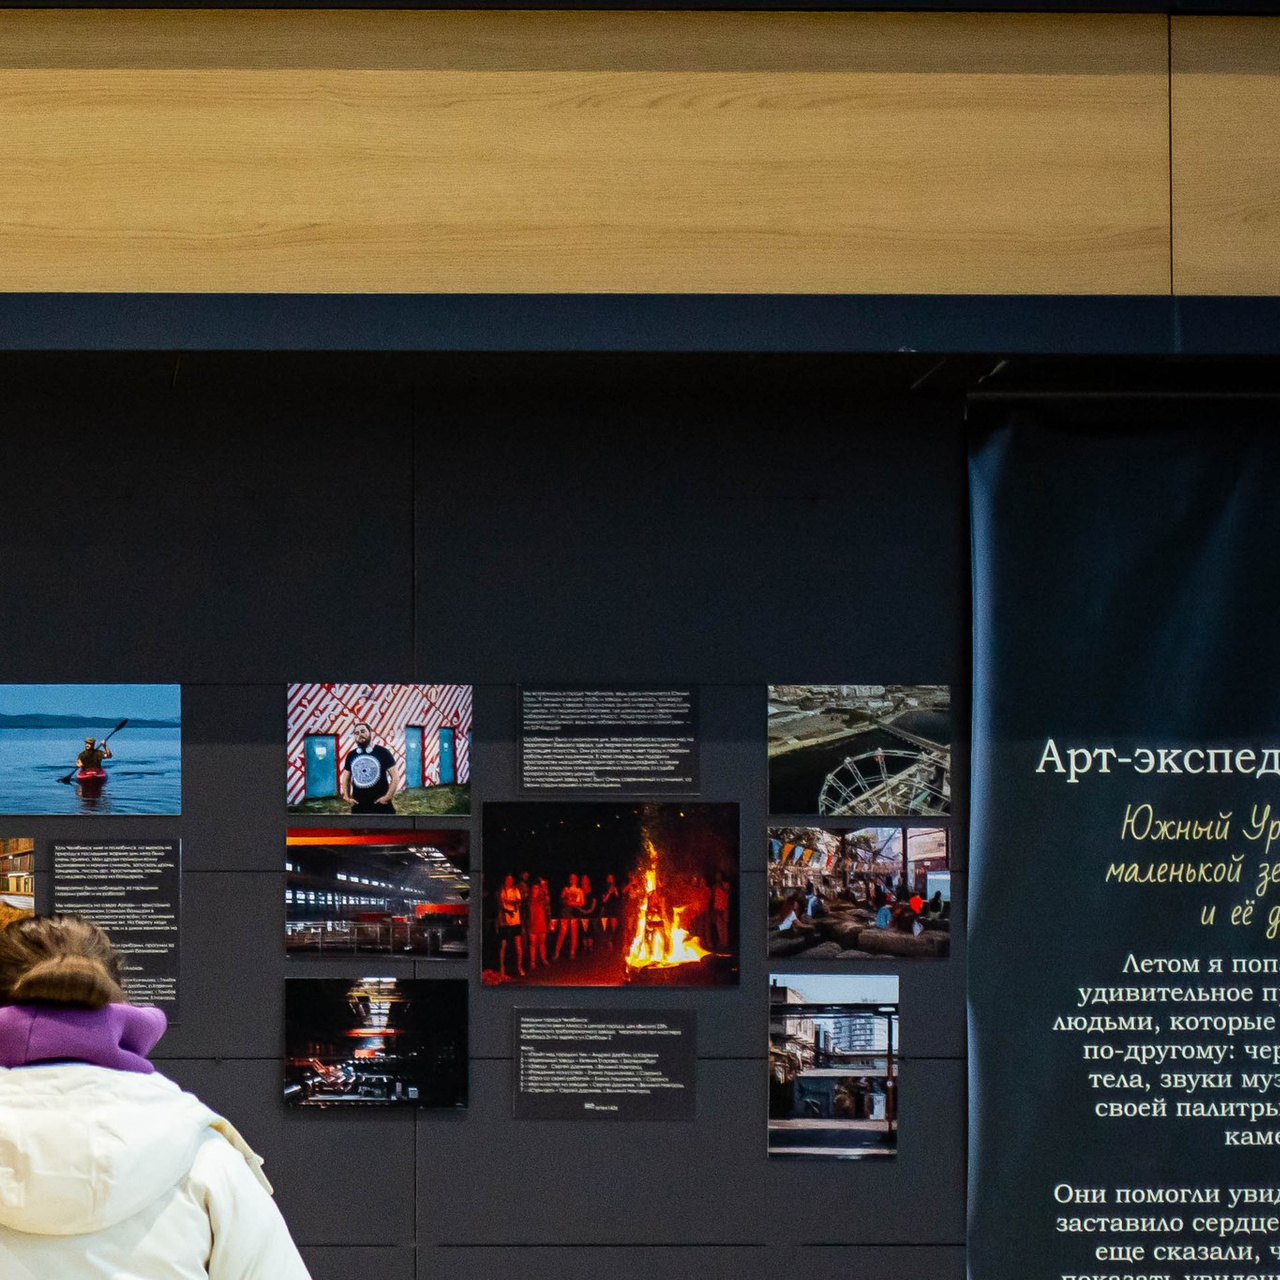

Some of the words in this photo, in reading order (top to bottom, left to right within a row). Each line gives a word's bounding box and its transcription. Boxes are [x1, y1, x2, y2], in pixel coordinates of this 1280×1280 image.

[1121, 804, 1233, 842] Южный
[1105, 854, 1245, 883] маленькой
[1200, 905, 1216, 925] и
[1230, 899, 1256, 926] её
[1122, 953, 1200, 973] Летом
[1207, 958, 1223, 973] я
[1231, 958, 1280, 973] поп
[1077, 987, 1254, 1008] удивительное
[1051, 1016, 1160, 1035] людьми,
[1169, 1016, 1276, 1036] которые
[1082, 1044, 1235, 1065] по-другому:
[1088, 1073, 1151, 1092] тела,
[1160, 1073, 1233, 1094] звуки
[1094, 1097, 1168, 1117] своей
[1053, 1183, 1107, 1204] Они
[1115, 1188, 1221, 1204] помогли
[1056, 1217, 1184, 1233] заставило
[1192, 1217, 1280, 1238] сердце
[1095, 1246, 1145, 1264] еще
[1153, 1245, 1260, 1265] сказали,
